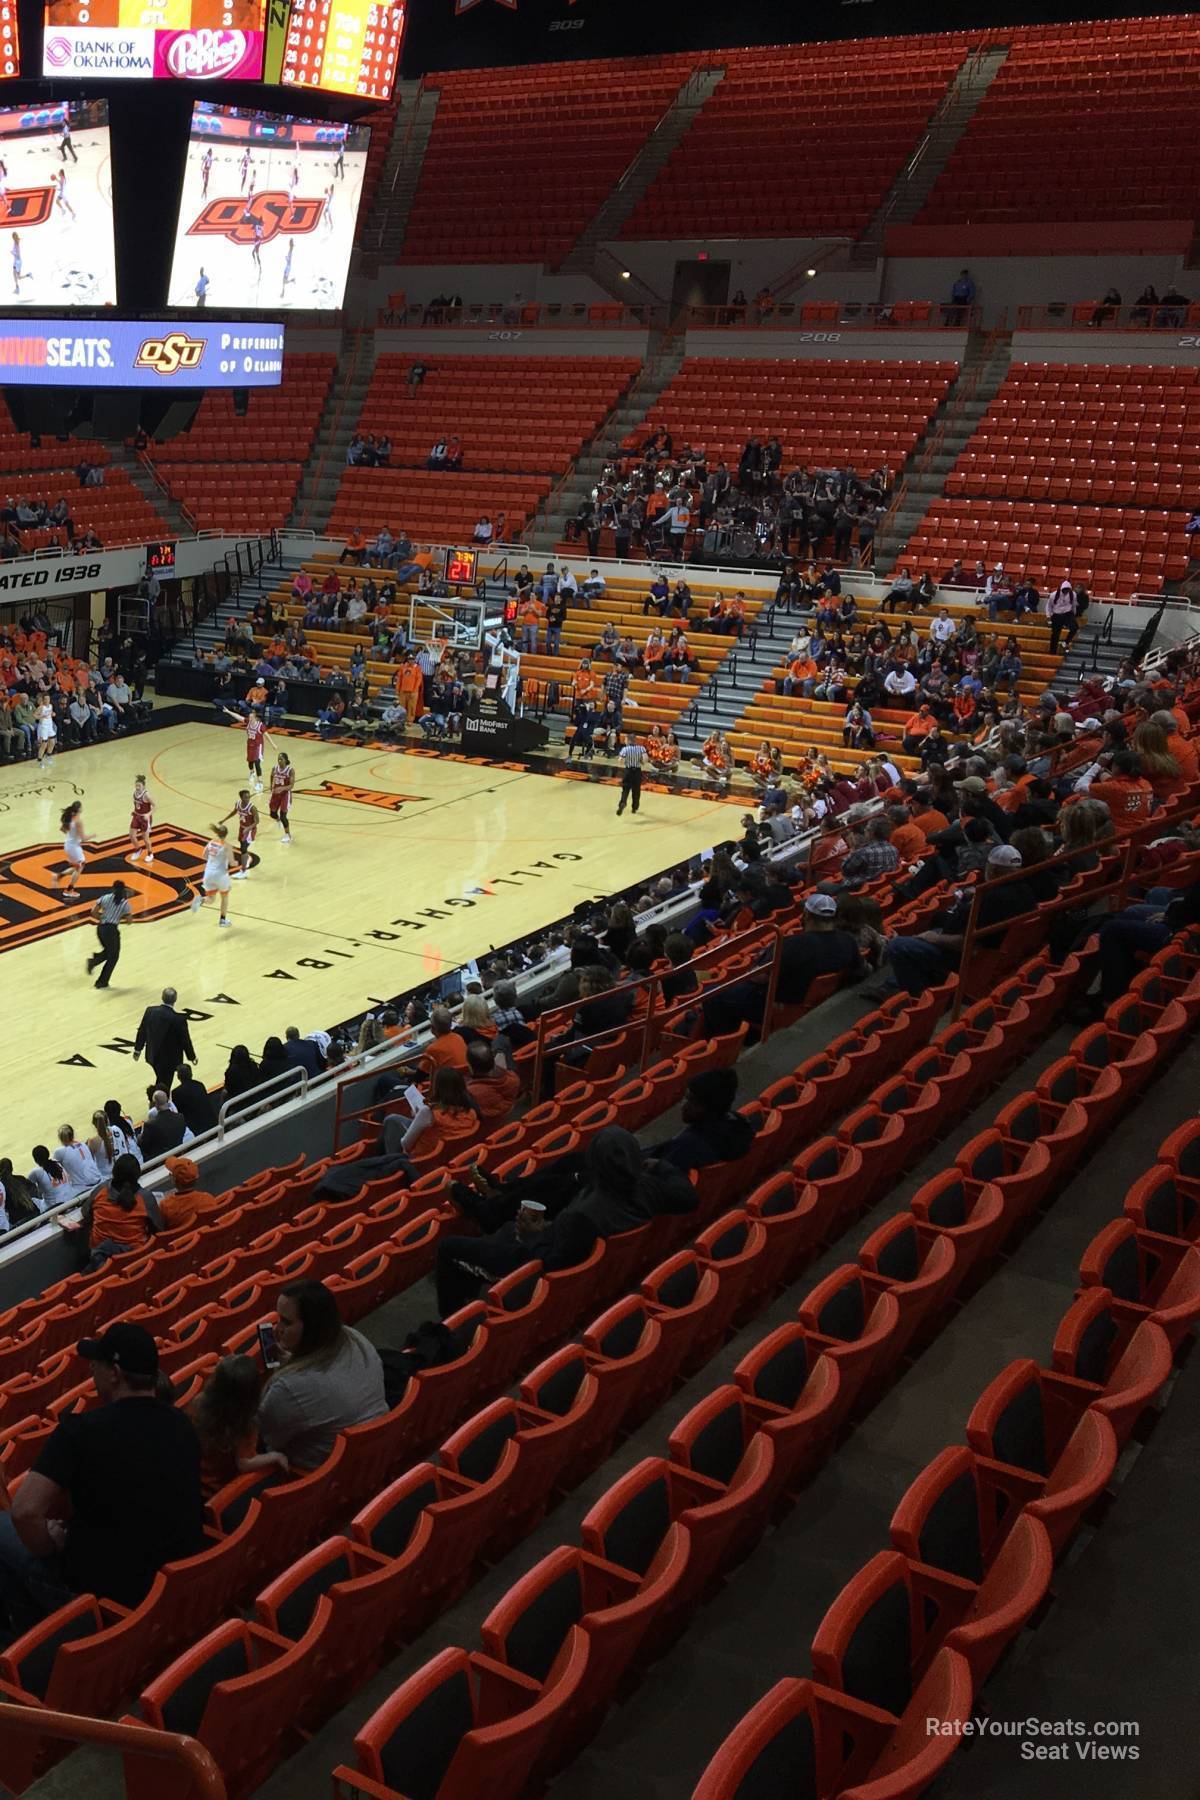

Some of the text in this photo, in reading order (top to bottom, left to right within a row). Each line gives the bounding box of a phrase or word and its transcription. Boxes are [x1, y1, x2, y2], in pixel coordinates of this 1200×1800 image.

[223, 13, 232, 25] 3
[549, 19, 585, 31] 309
[75, 41, 136, 54] BANK OF
[73, 55, 151, 69] OKLAHOMA
[186, 191, 328, 245] OSU
[488, 332, 521, 342] 207
[800, 333, 841, 343] 208
[134, 331, 208, 376] OSU
[455, 551, 474, 562] 7:34
[54, 564, 101, 583] 1938
[450, 562, 471, 579] 27
[56, 993, 242, 1068] ARNA
